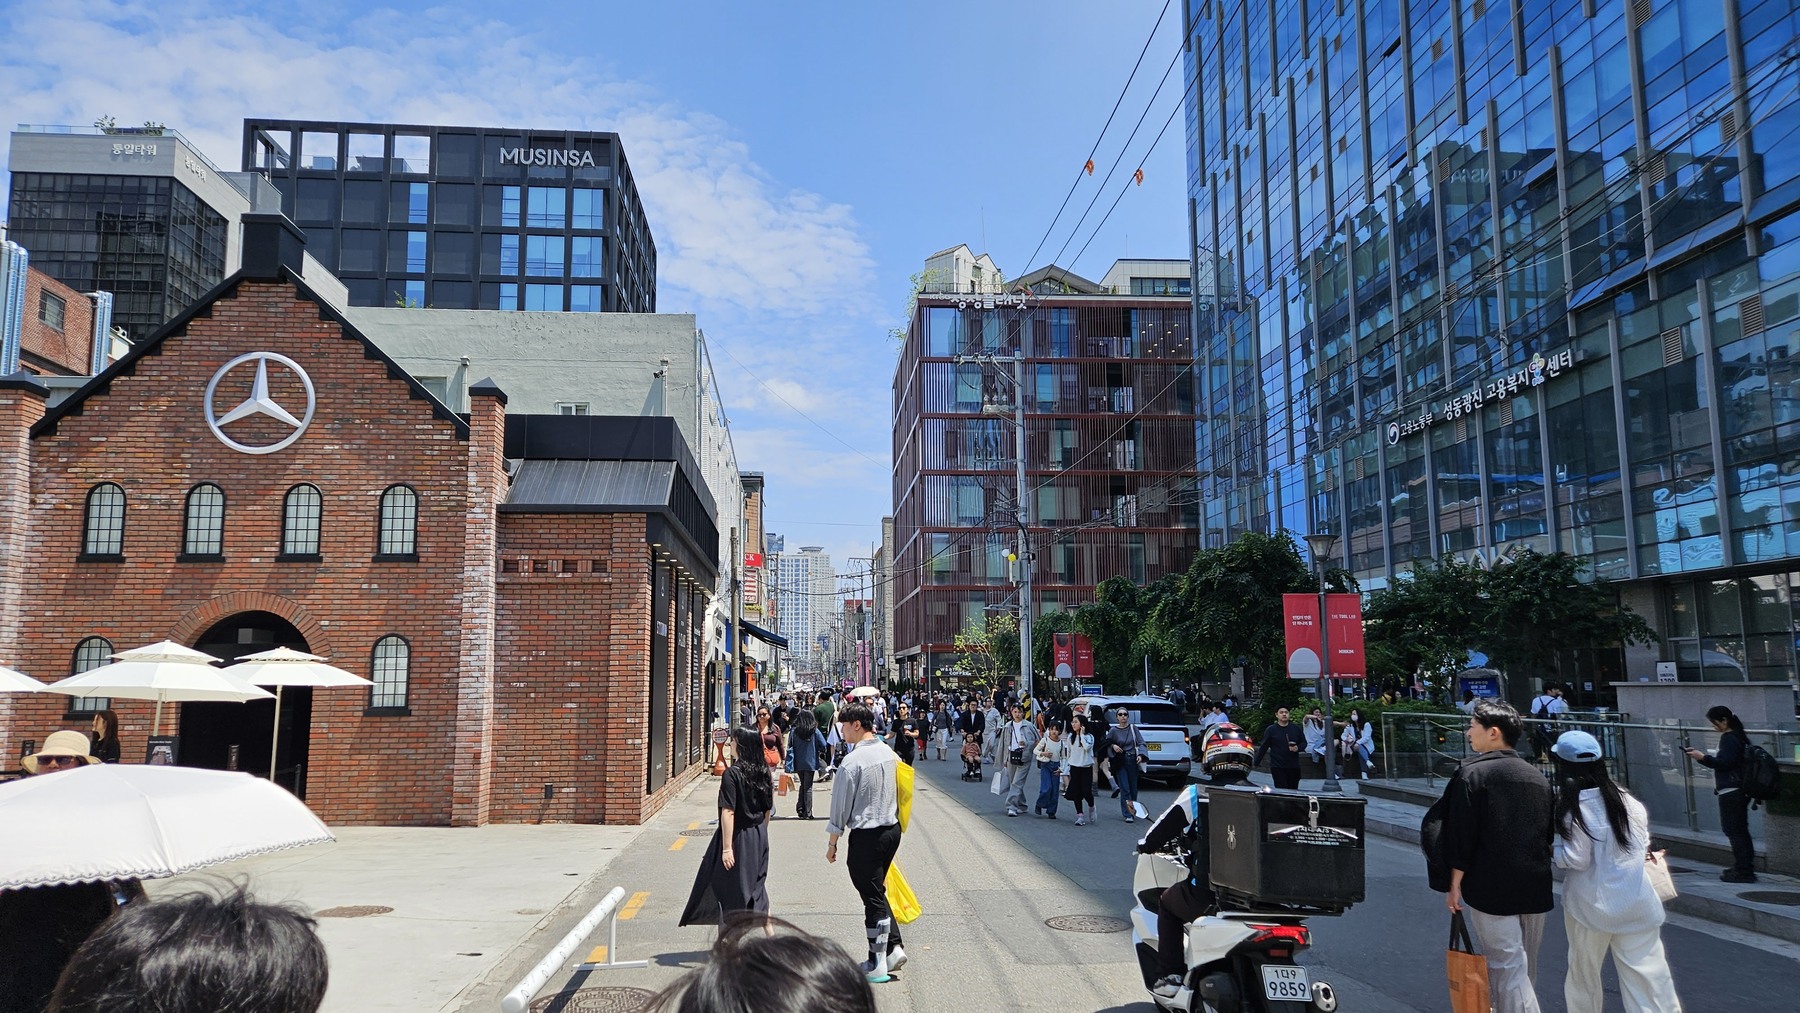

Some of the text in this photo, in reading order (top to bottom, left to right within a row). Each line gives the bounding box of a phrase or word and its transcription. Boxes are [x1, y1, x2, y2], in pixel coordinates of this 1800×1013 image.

[112, 144, 157, 156] 통일타워
[500, 147, 596, 167] MUSINSA
[950, 292, 1027, 310] 상상플래닛
[1400, 349, 1573, 437] 고용노동부 성동광진 고용복지 센터
[1274, 969, 1297, 980] 1다9
[1269, 981, 1307, 998] 9859
